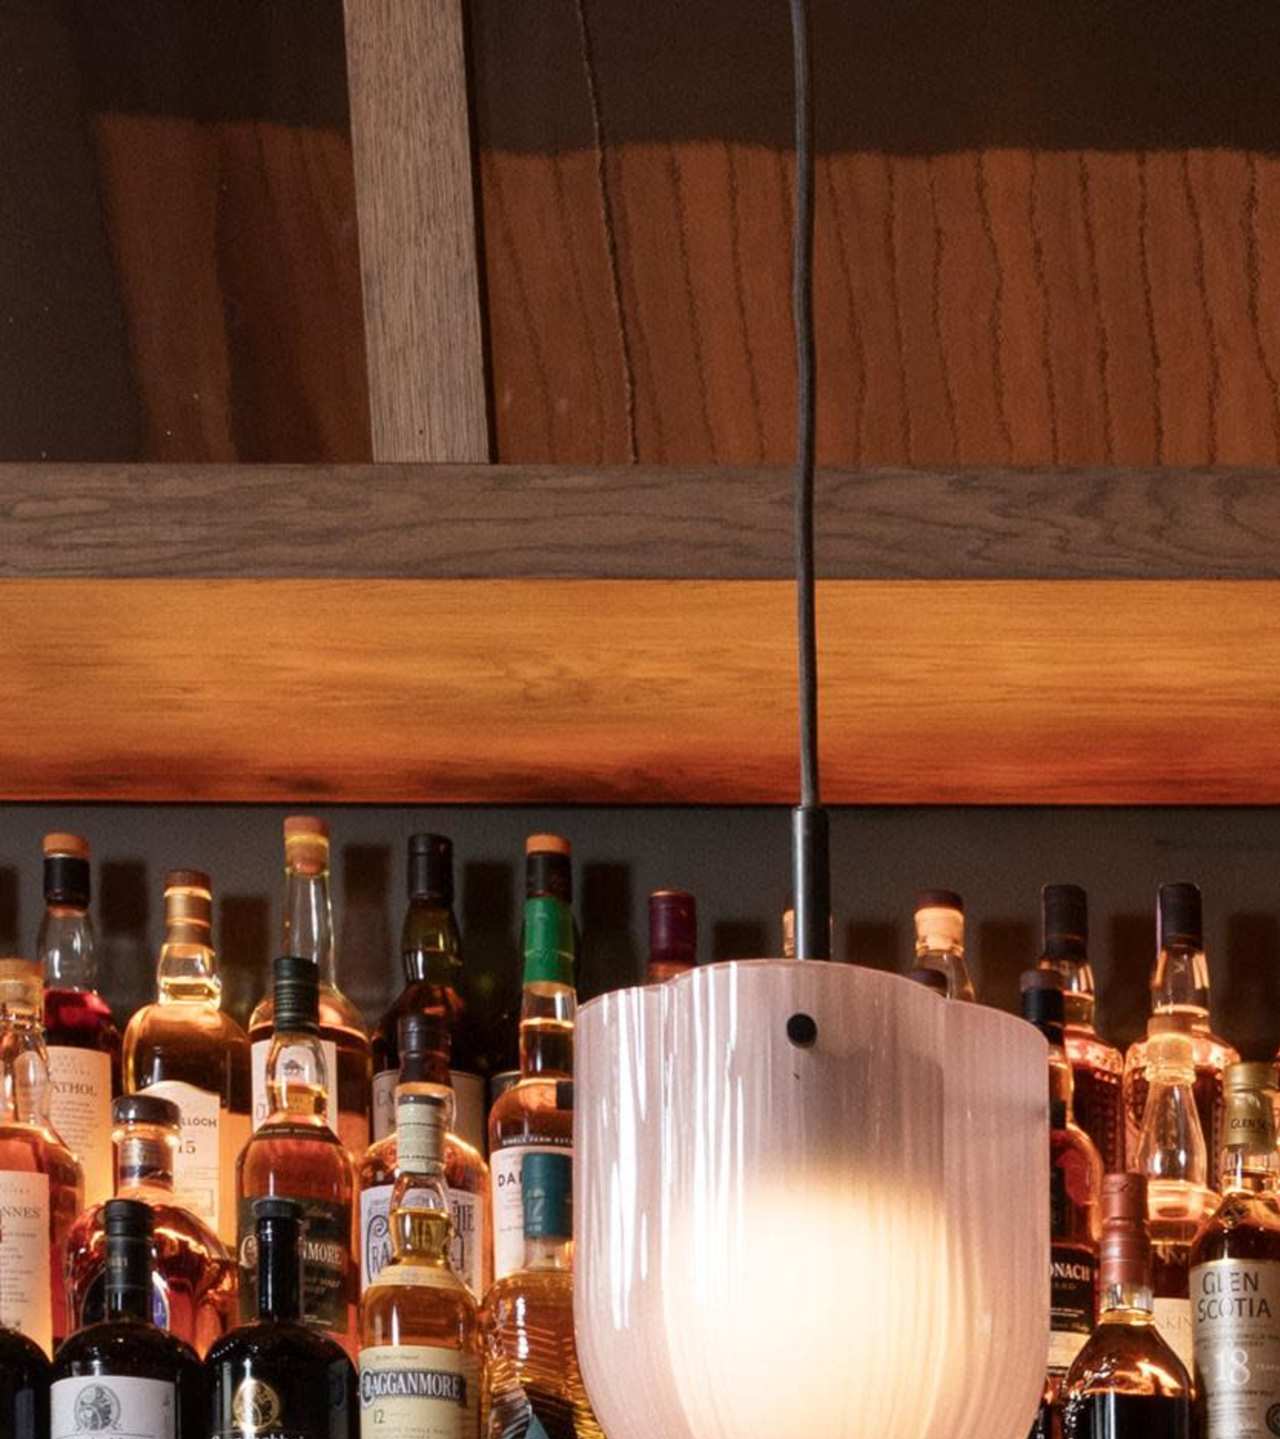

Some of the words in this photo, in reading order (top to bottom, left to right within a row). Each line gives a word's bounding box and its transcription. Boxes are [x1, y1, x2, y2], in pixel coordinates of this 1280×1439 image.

[1201, 1270, 1260, 1296] GLEN
[1197, 1296, 1273, 1323] SCOTIA
[1213, 1349, 1251, 1386] 18
[360, 1368, 460, 1409] CRAGGANMORE
